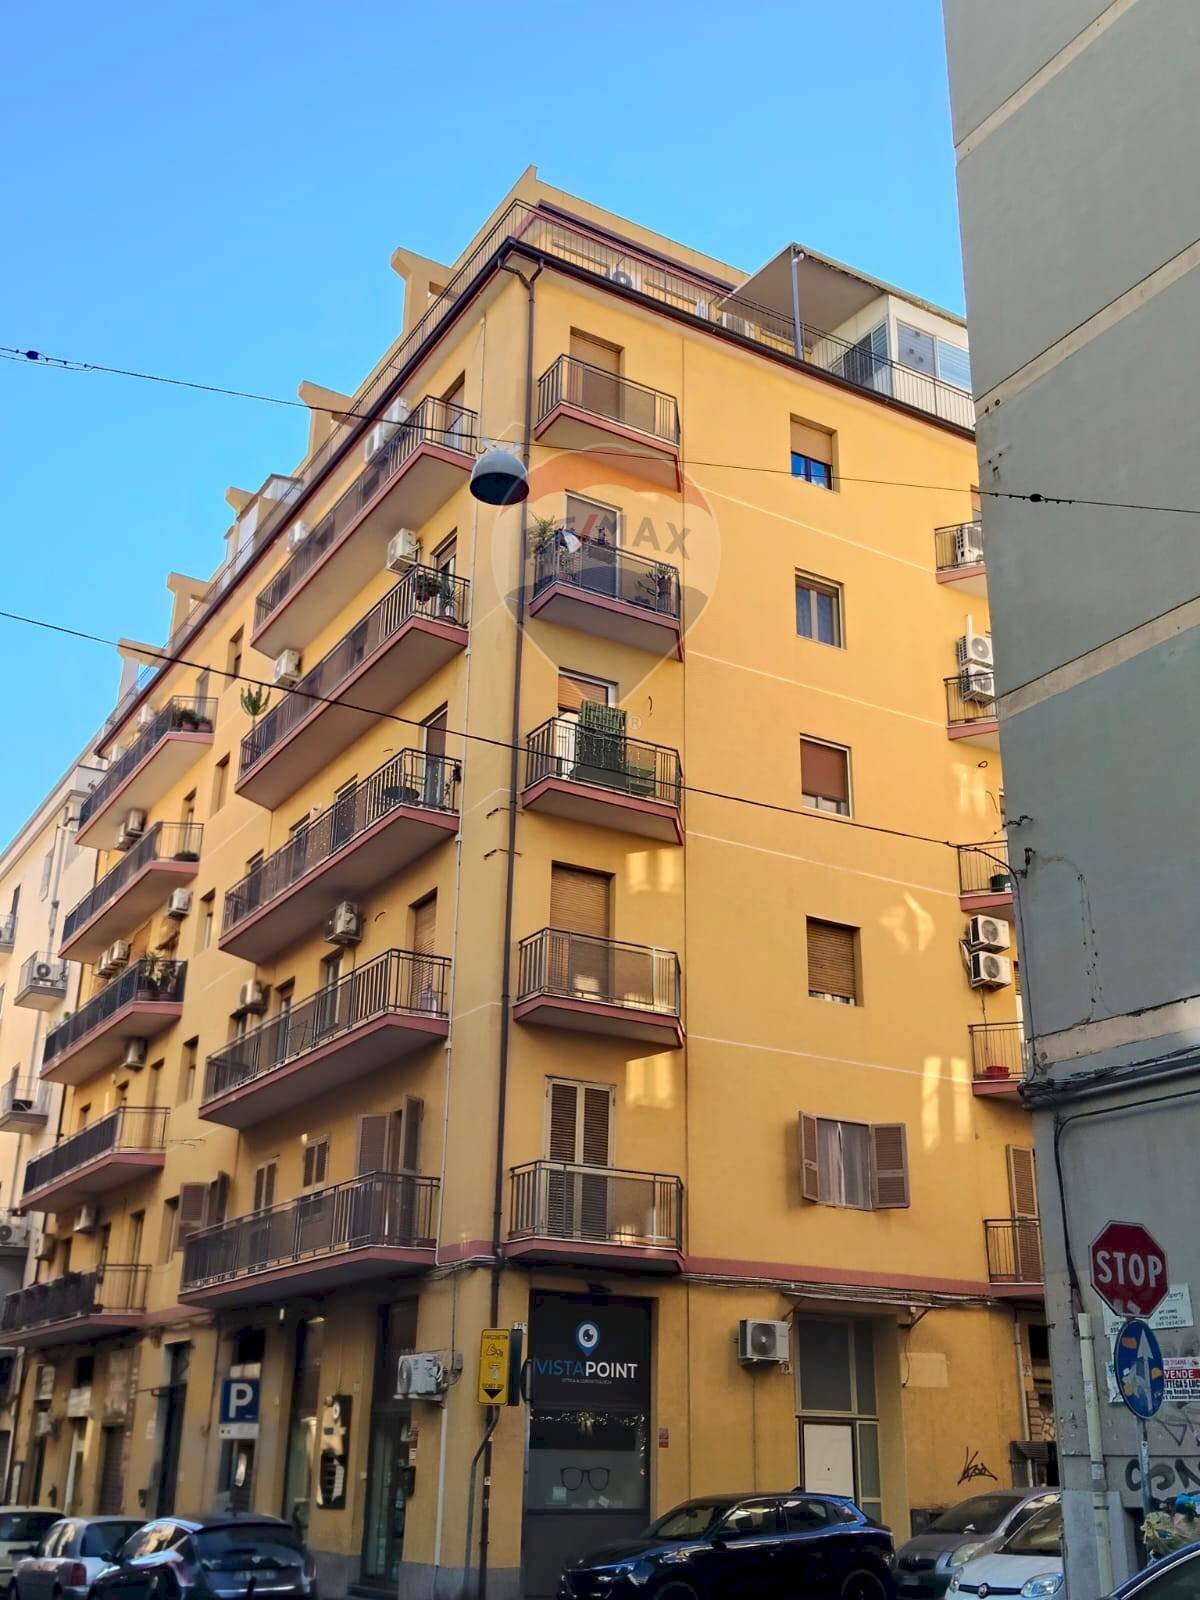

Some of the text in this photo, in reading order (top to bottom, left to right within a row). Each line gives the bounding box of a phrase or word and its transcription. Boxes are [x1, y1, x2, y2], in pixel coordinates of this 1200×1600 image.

[1096, 1249, 1163, 1288] STOP
[1164, 1369, 1195, 1379] VENDE
[1165, 1379, 1183, 1388] TTEGA
[1188, 1379, 1200, 1388] LUC
[228, 1382, 254, 1419] P
